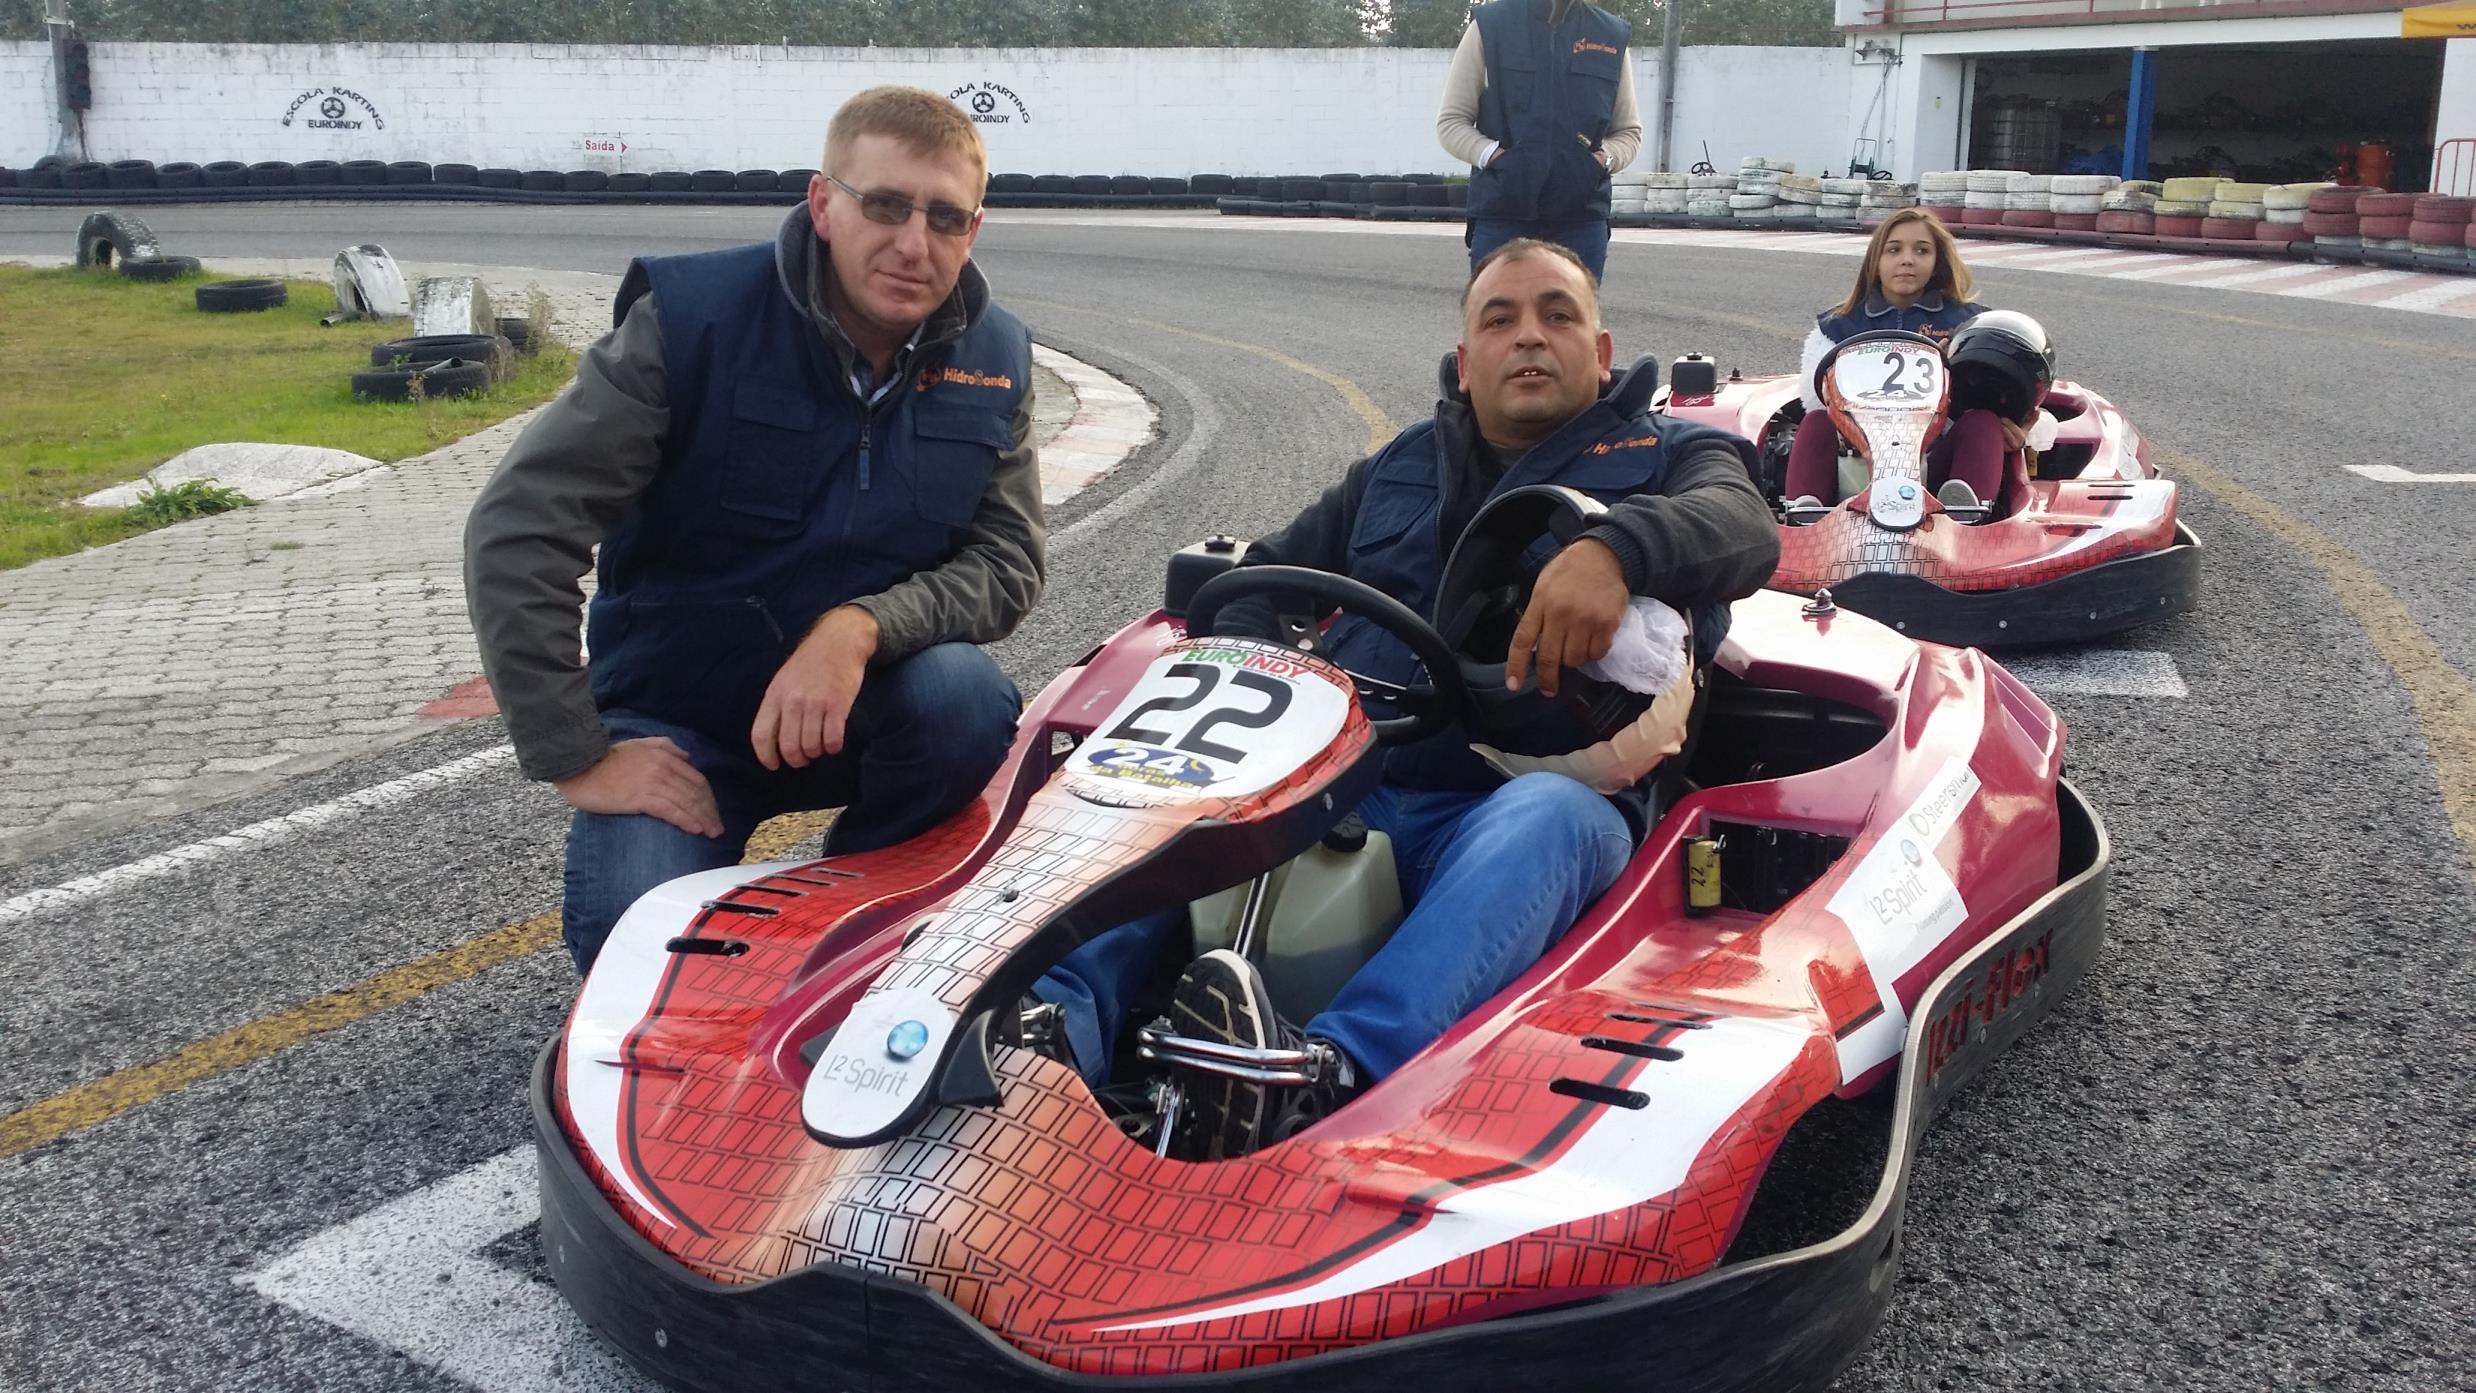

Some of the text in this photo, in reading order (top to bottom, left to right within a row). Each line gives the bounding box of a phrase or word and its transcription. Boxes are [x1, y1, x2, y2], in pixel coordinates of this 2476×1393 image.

[282, 86, 385, 130] ESCOLA KARTING
[983, 81, 1031, 124] KARTING
[308, 119, 362, 130] EUROINDY
[971, 113, 1010, 124] ROINDY
[943, 367, 1012, 390] HidroSonda
[1882, 352, 1935, 394] 23
[1182, 650, 1309, 679] EUROINDY
[1104, 663, 1293, 765] 22
[1101, 746, 1189, 776] 24
